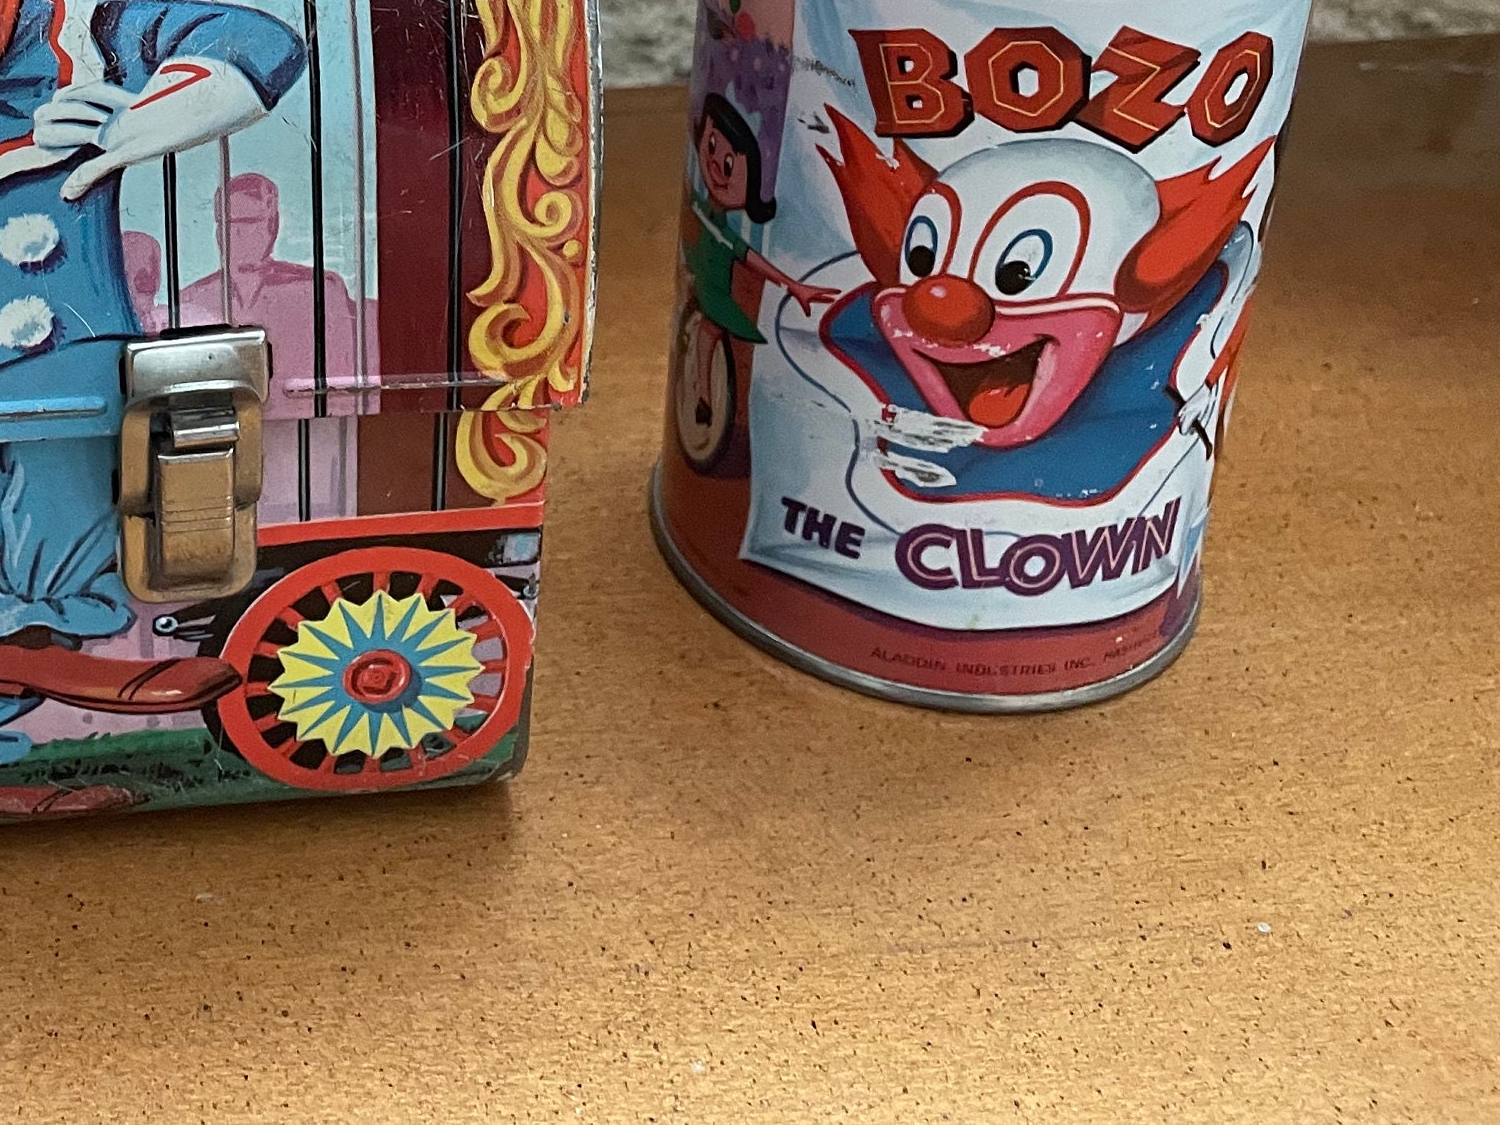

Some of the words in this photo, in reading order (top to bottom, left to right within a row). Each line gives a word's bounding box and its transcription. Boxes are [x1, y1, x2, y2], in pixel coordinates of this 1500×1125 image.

[848, 25, 1274, 154] BOZO
[781, 496, 866, 560] THE
[895, 496, 1182, 597] CLOWN
[870, 646, 946, 672] ALADDIN
[955, 660, 1057, 676] INDUSTRIES
